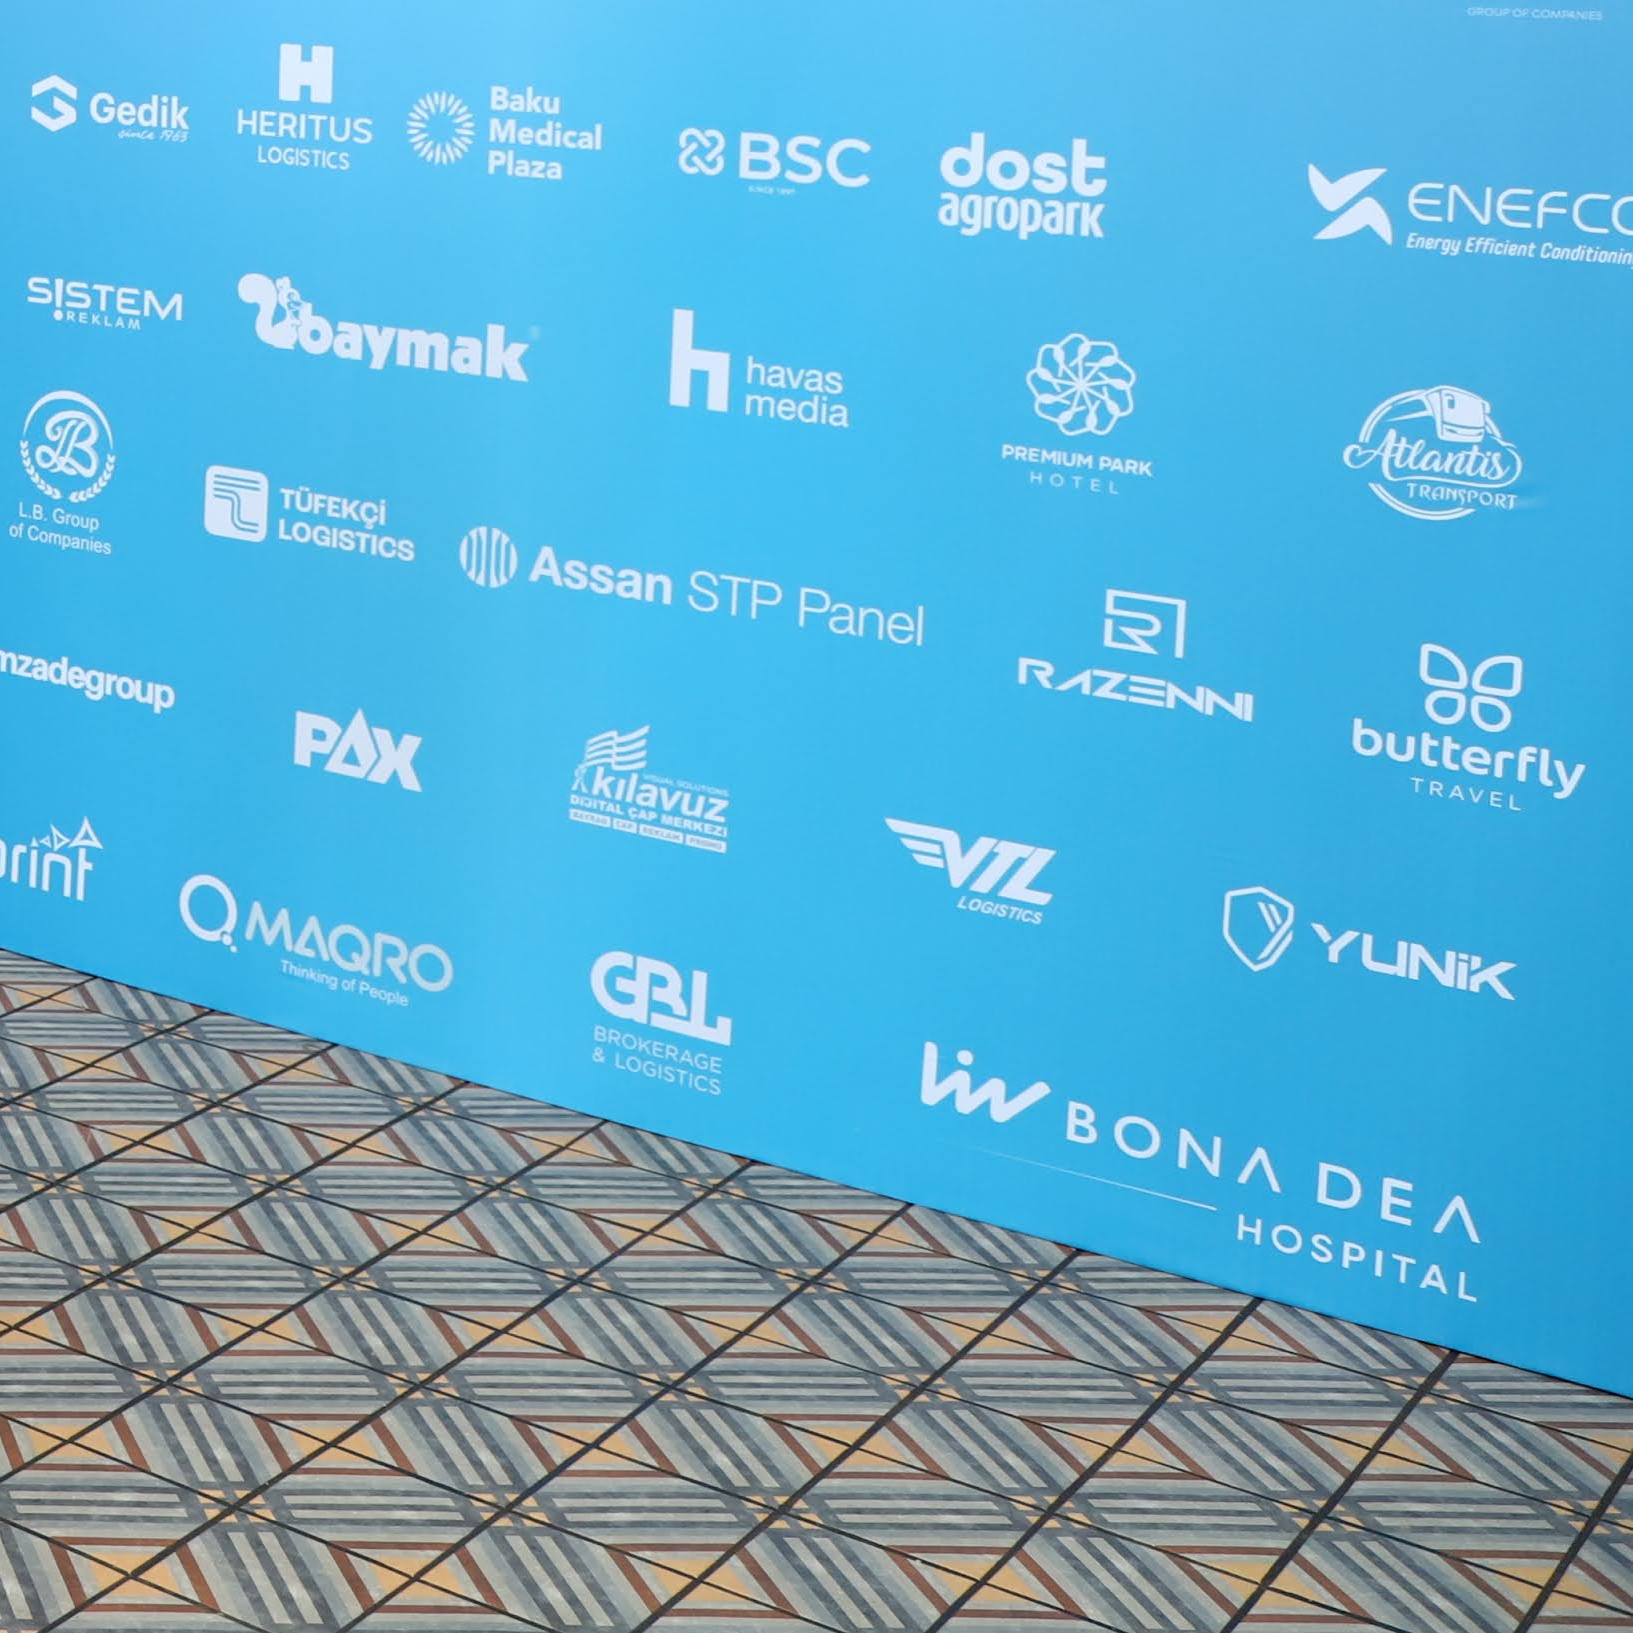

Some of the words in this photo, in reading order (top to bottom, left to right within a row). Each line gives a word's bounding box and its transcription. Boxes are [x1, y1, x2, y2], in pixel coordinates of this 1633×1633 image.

[90, 92, 189, 129] Gedik
[490, 85, 560, 115] Baku
[237, 109, 374, 144] HERITUS
[489, 118, 603, 151] Medical
[257, 146, 350, 170] LOGISTICS
[488, 150, 563, 180] Plaza
[739, 131, 872, 188] BSC
[940, 132, 1108, 198] dost
[938, 192, 1105, 240] agropark
[1406, 232, 1461, 256] Energy
[1465, 236, 1536, 258] Efficient
[1540, 242, 1633, 269] Conditionin
[66, 311, 141, 330] REKLAM
[298, 301, 529, 383] baymak
[745, 355, 844, 395] havas
[745, 394, 849, 428] media
[1001, 444, 1093, 470] PREMIUM
[1099, 455, 1154, 478] PARK
[1343, 428, 1510, 482] Atlantis
[1030, 471, 1120, 496] HOTEL
[1407, 483, 1518, 510] TRANSPORT
[19, 502, 48, 524] L.B.
[52, 508, 100, 533] Group
[280, 485, 387, 530] TÜFEKÇİ
[9, 523, 26, 540] of
[27, 525, 112, 556] Companies
[278, 518, 415, 562] LOGISTICS
[528, 546, 673, 605] Assan
[687, 570, 782, 620] STP
[798, 587, 924, 647] Panel
[1018, 656, 1254, 723] RAZENNI
[293, 708, 423, 793] PAX
[1352, 718, 1586, 800] butterfly
[1409, 777, 1522, 812] TRAVEL
[956, 895, 1043, 926] LOGISTICS
[245, 900, 454, 993] MAQRO
[280, 958, 338, 992] Thinking
[341, 975, 356, 993] of
[358, 978, 409, 1008] People
[594, 1025, 723, 1074] BROKERAGE
[592, 1047, 605, 1063] &
[615, 1052, 721, 1096] LOGISTICS
[1065, 1099, 1282, 1195] BONA
[1316, 1161, 1482, 1245] DEA
[1236, 1213, 1478, 1303] HOSPITAL
